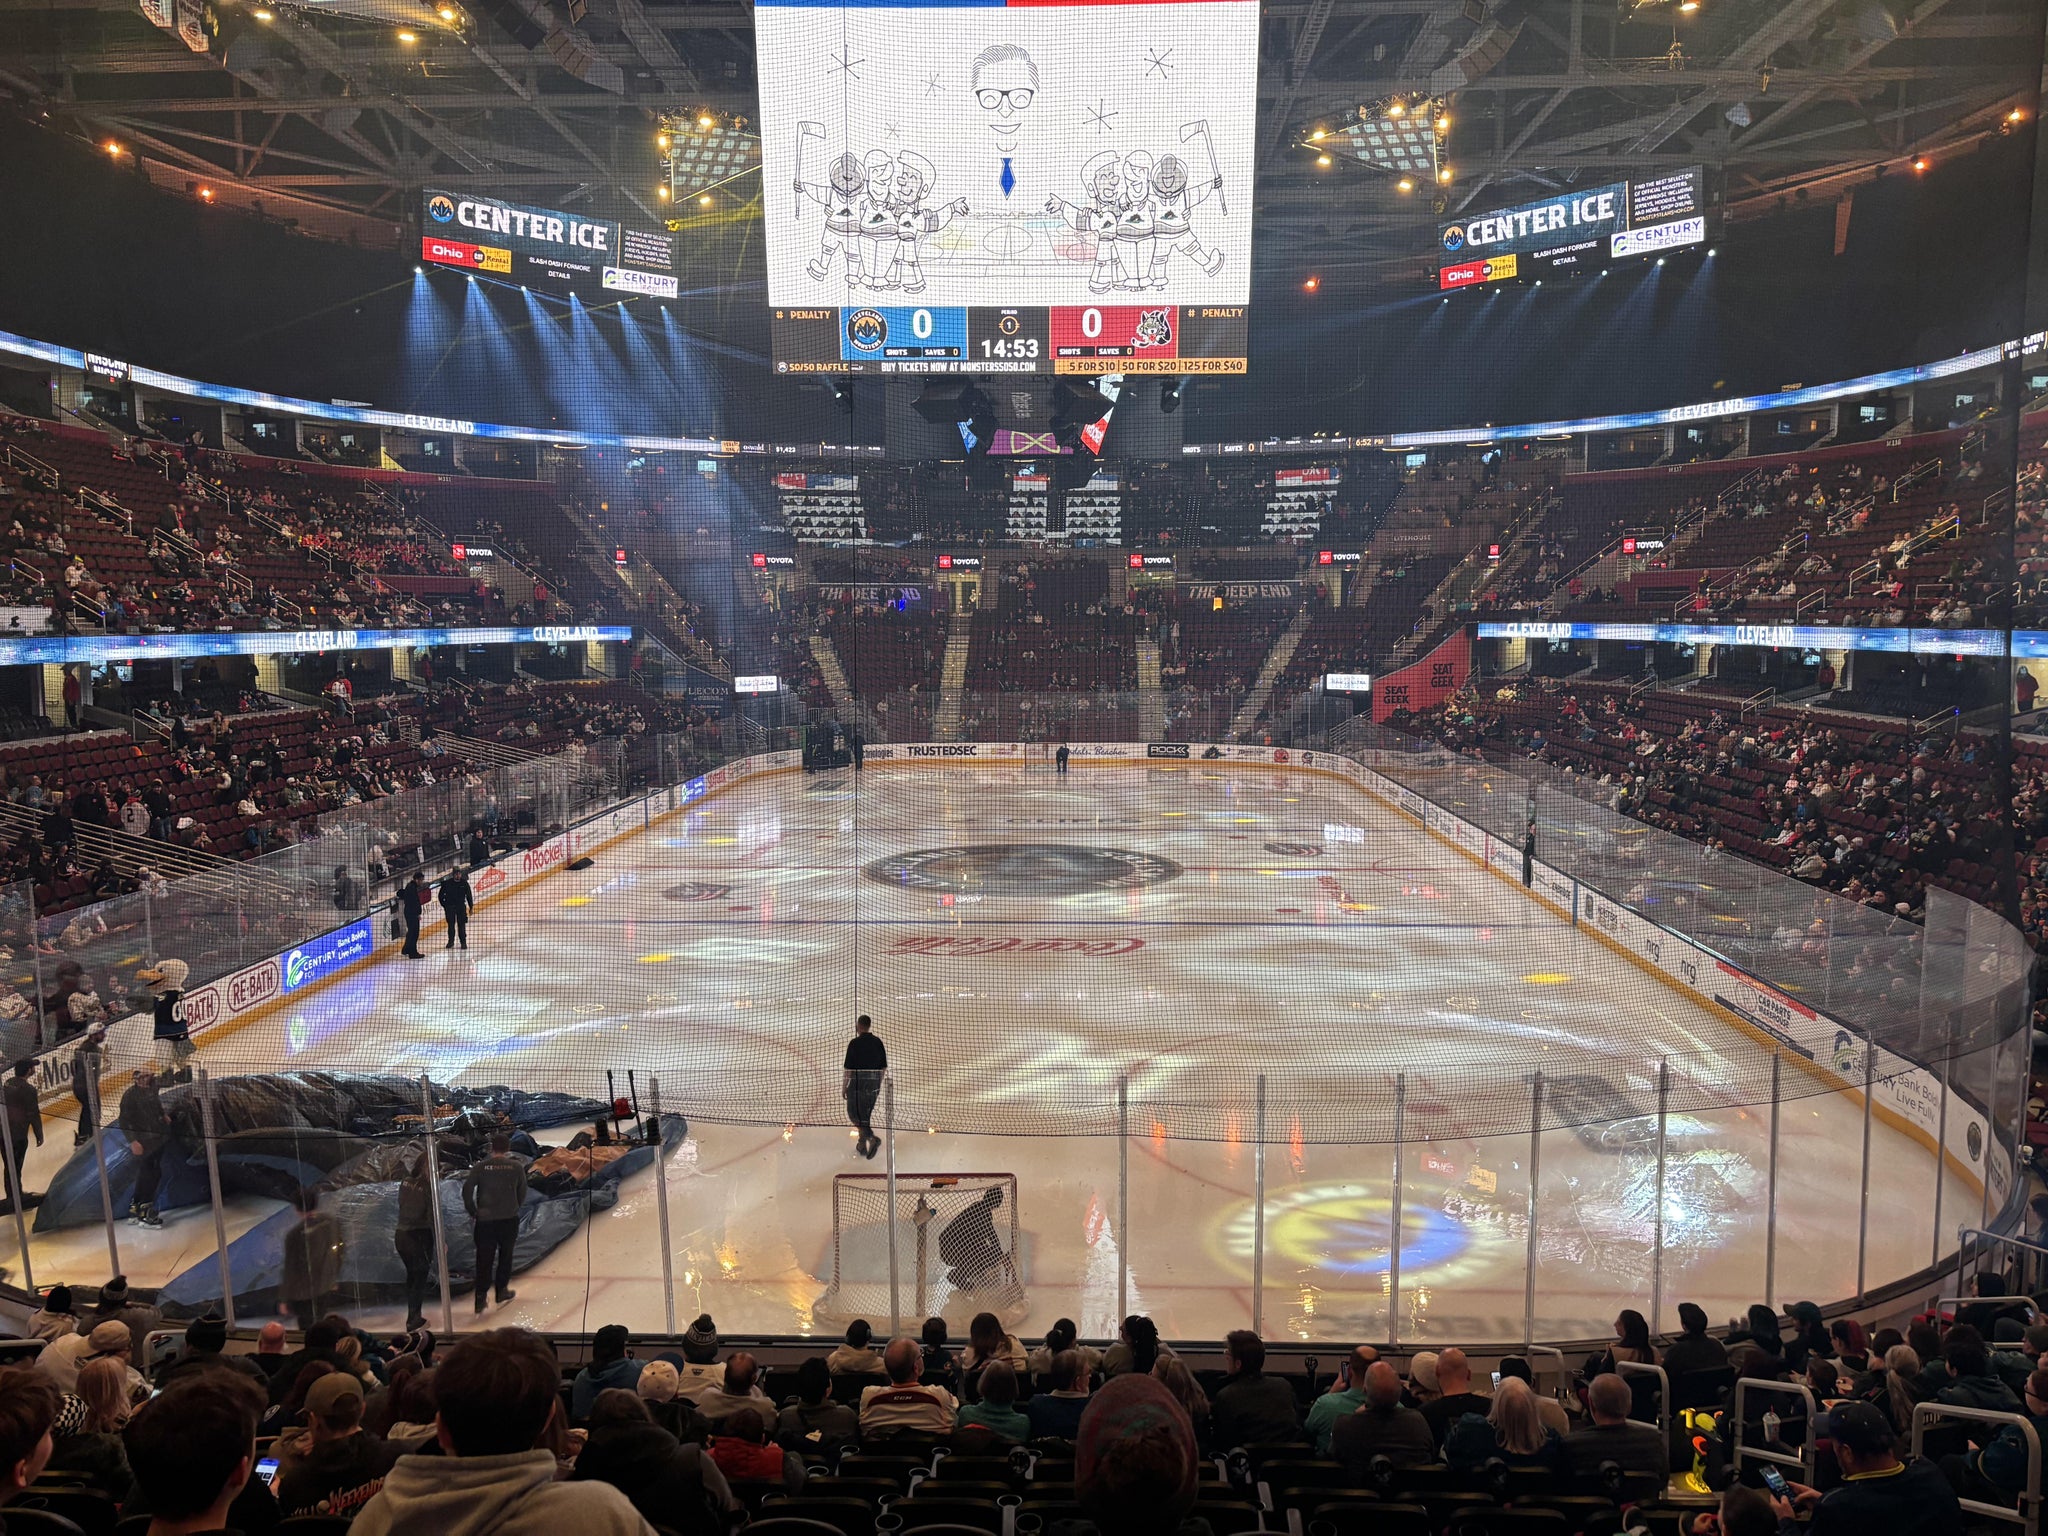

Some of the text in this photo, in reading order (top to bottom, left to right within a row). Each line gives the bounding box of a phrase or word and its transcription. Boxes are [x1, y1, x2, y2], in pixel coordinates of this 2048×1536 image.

[1466, 192, 1615, 246] CENTER ICE
[457, 201, 564, 243] CENTER
[569, 221, 609, 251] ICE
[1636, 220, 1701, 241] CENTURY
[432, 245, 464, 259] Ohio
[486, 255, 510, 265] Rental
[624, 272, 676, 288] CENTURY
[1448, 270, 1474, 281] Ohio
[776, 310, 831, 319] # PENALTY
[851, 311, 883, 323] CLEVELAND
[1188, 309, 1244, 318] # PENALTY
[912, 309, 933, 339] 0
[1006, 321, 1012, 329] 1
[1081, 308, 1102, 338] 0
[885, 348, 908, 356] SHOTS
[924, 348, 959, 356] SAVES 0
[981, 339, 1039, 358] 14:53
[789, 363, 814, 372] 50/50
[816, 363, 849, 372] RAFFLE
[881, 362, 897, 372] BUY
[898, 362, 928, 372] TICKETS
[930, 362, 948, 372] NOW
[949, 362, 959, 372] AT
[1070, 361, 1115, 371] 5 FOR $10
[1122, 361, 1176, 371] 50 FOR $20
[1184, 361, 1243, 371] 125 FOR $40
[1669, 398, 1744, 420] CLEVELAND
[404, 415, 475, 434] CLEVELAND
[1224, 443, 1254, 453] SAVES 0
[1356, 438, 1372, 447] 6:52
[1636, 540, 1664, 549] TOYOTA
[466, 548, 493, 556] TOYOTA
[1189, 585, 1217, 599] THE
[1260, 585, 1292, 598] END
[533, 627, 598, 641] CLEVELAND
[1506, 623, 1572, 637] CLEVELAND
[1736, 626, 1794, 645] CLEVELAND
[296, 630, 357, 649] CLEVELAND
[1432, 663, 1454, 675] SEAT
[1431, 676, 1454, 688] GEEK
[688, 687, 729, 695] LECOM
[1385, 686, 1408, 695] SEAT
[1383, 695, 1409, 704] GEEK
[907, 745, 977, 757] TRUSTEDSEC
[533, 843, 564, 870] Rocket
[337, 935, 350, 948] Bank
[338, 948, 349, 960] Live
[1646, 938, 1660, 962] nrg
[303, 949, 336, 972] CENTURY
[305, 971, 315, 979] FCU
[1681, 959, 1697, 984] nrg
[1759, 995, 1791, 1020] CAR PARTS
[1759, 1005, 1789, 1028] WAREHOUSE
[1898, 1073, 1921, 1095] Bank
[1896, 1089, 1916, 1110] Live
